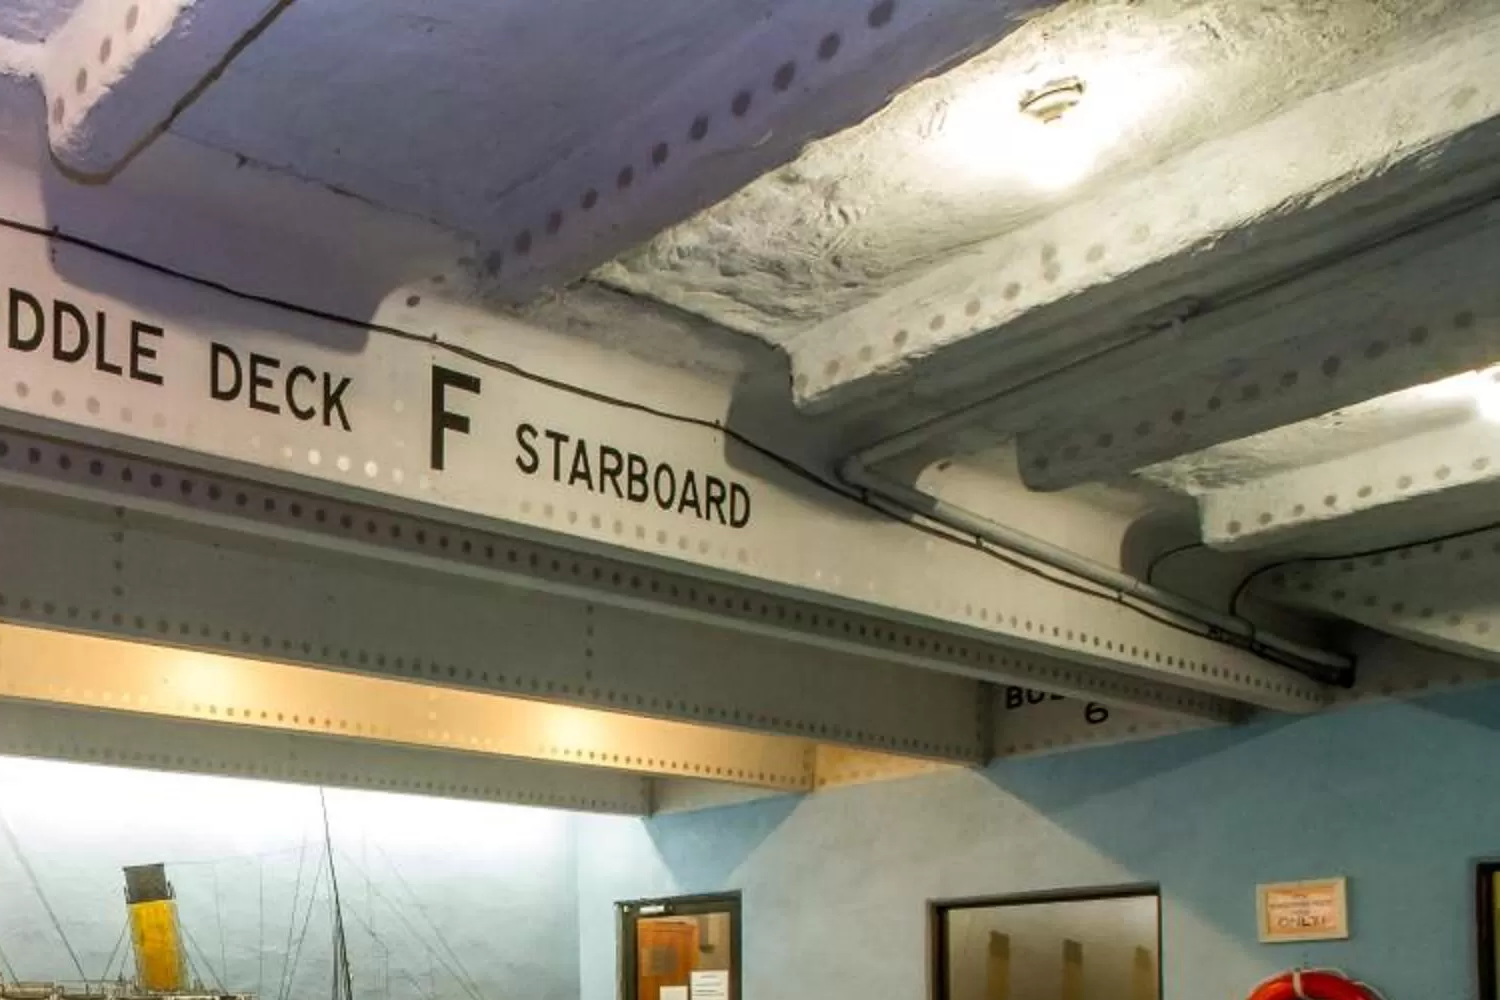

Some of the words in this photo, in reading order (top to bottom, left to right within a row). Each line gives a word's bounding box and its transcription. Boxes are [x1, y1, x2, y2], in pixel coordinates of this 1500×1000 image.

[210, 341, 352, 432] DECK
[431, 364, 481, 471] F
[515, 423, 751, 530] STARBOARD
[1085, 702, 1109, 724] 6
